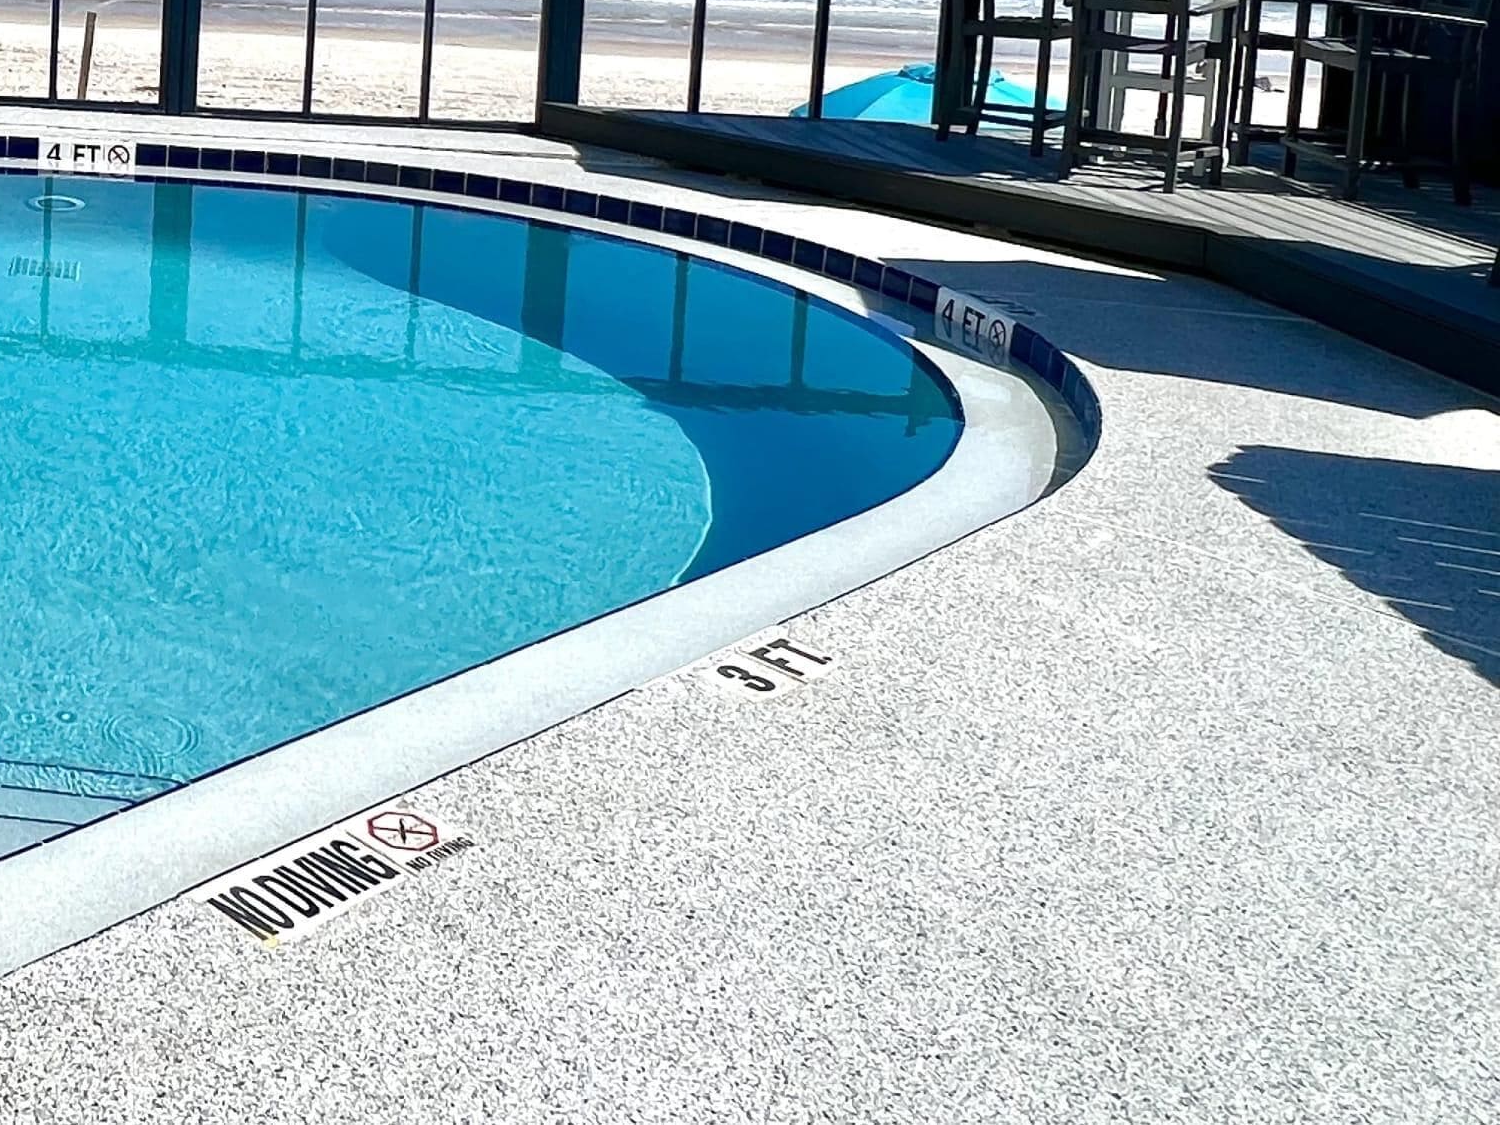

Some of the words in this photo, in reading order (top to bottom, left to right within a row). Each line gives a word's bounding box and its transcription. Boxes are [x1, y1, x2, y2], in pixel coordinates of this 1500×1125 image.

[47, 143, 61, 160] 4
[73, 144, 101, 163] FT
[942, 298, 955, 321] 4
[963, 305, 986, 336] FT
[717, 665, 776, 691] 3
[405, 854, 430, 872] NO
[427, 836, 474, 865] DIVING
[207, 886, 295, 940] NO
[251, 839, 401, 918] DIVING
